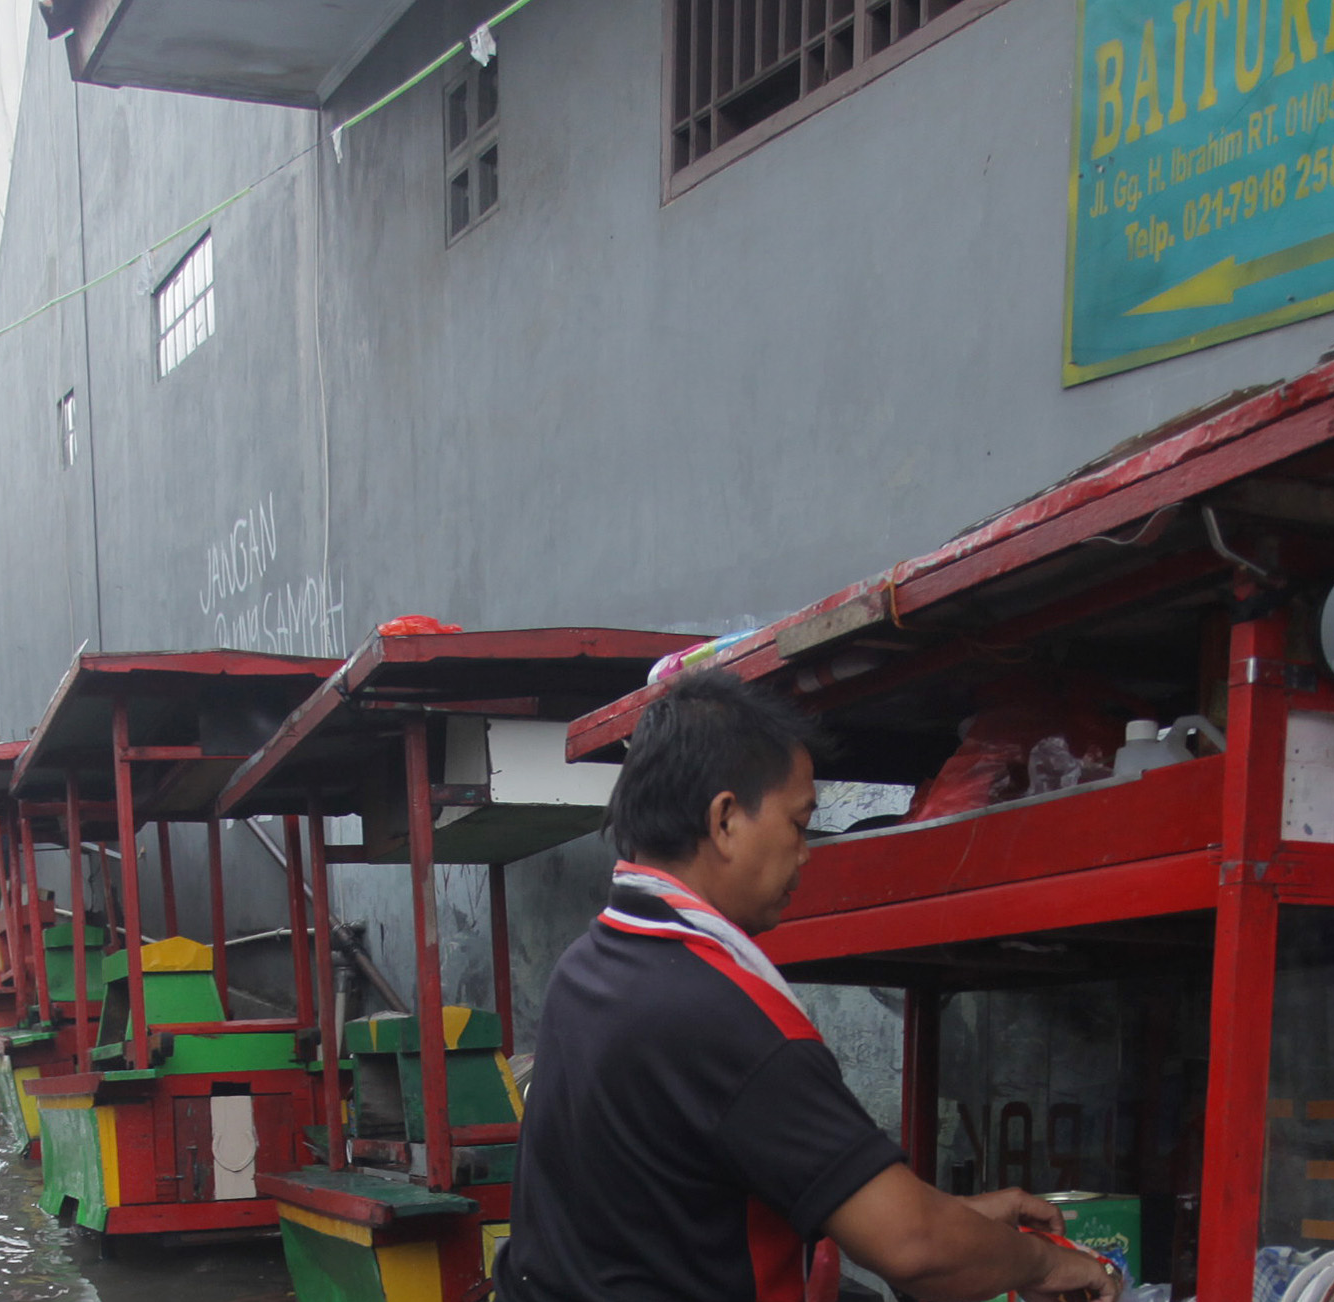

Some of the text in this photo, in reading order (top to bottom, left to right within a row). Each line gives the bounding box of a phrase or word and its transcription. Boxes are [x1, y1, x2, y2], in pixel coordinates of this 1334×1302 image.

[1114, 170, 1143, 212] Gg.
[1147, 155, 1166, 195] H.
[1170, 127, 1243, 186] Ibrahim
[1247, 104, 1279, 154] RT.
[1124, 214, 1175, 263] Telp.
[1182, 163, 1287, 242] 021-7918
[199, 491, 276, 615] JANGAN
